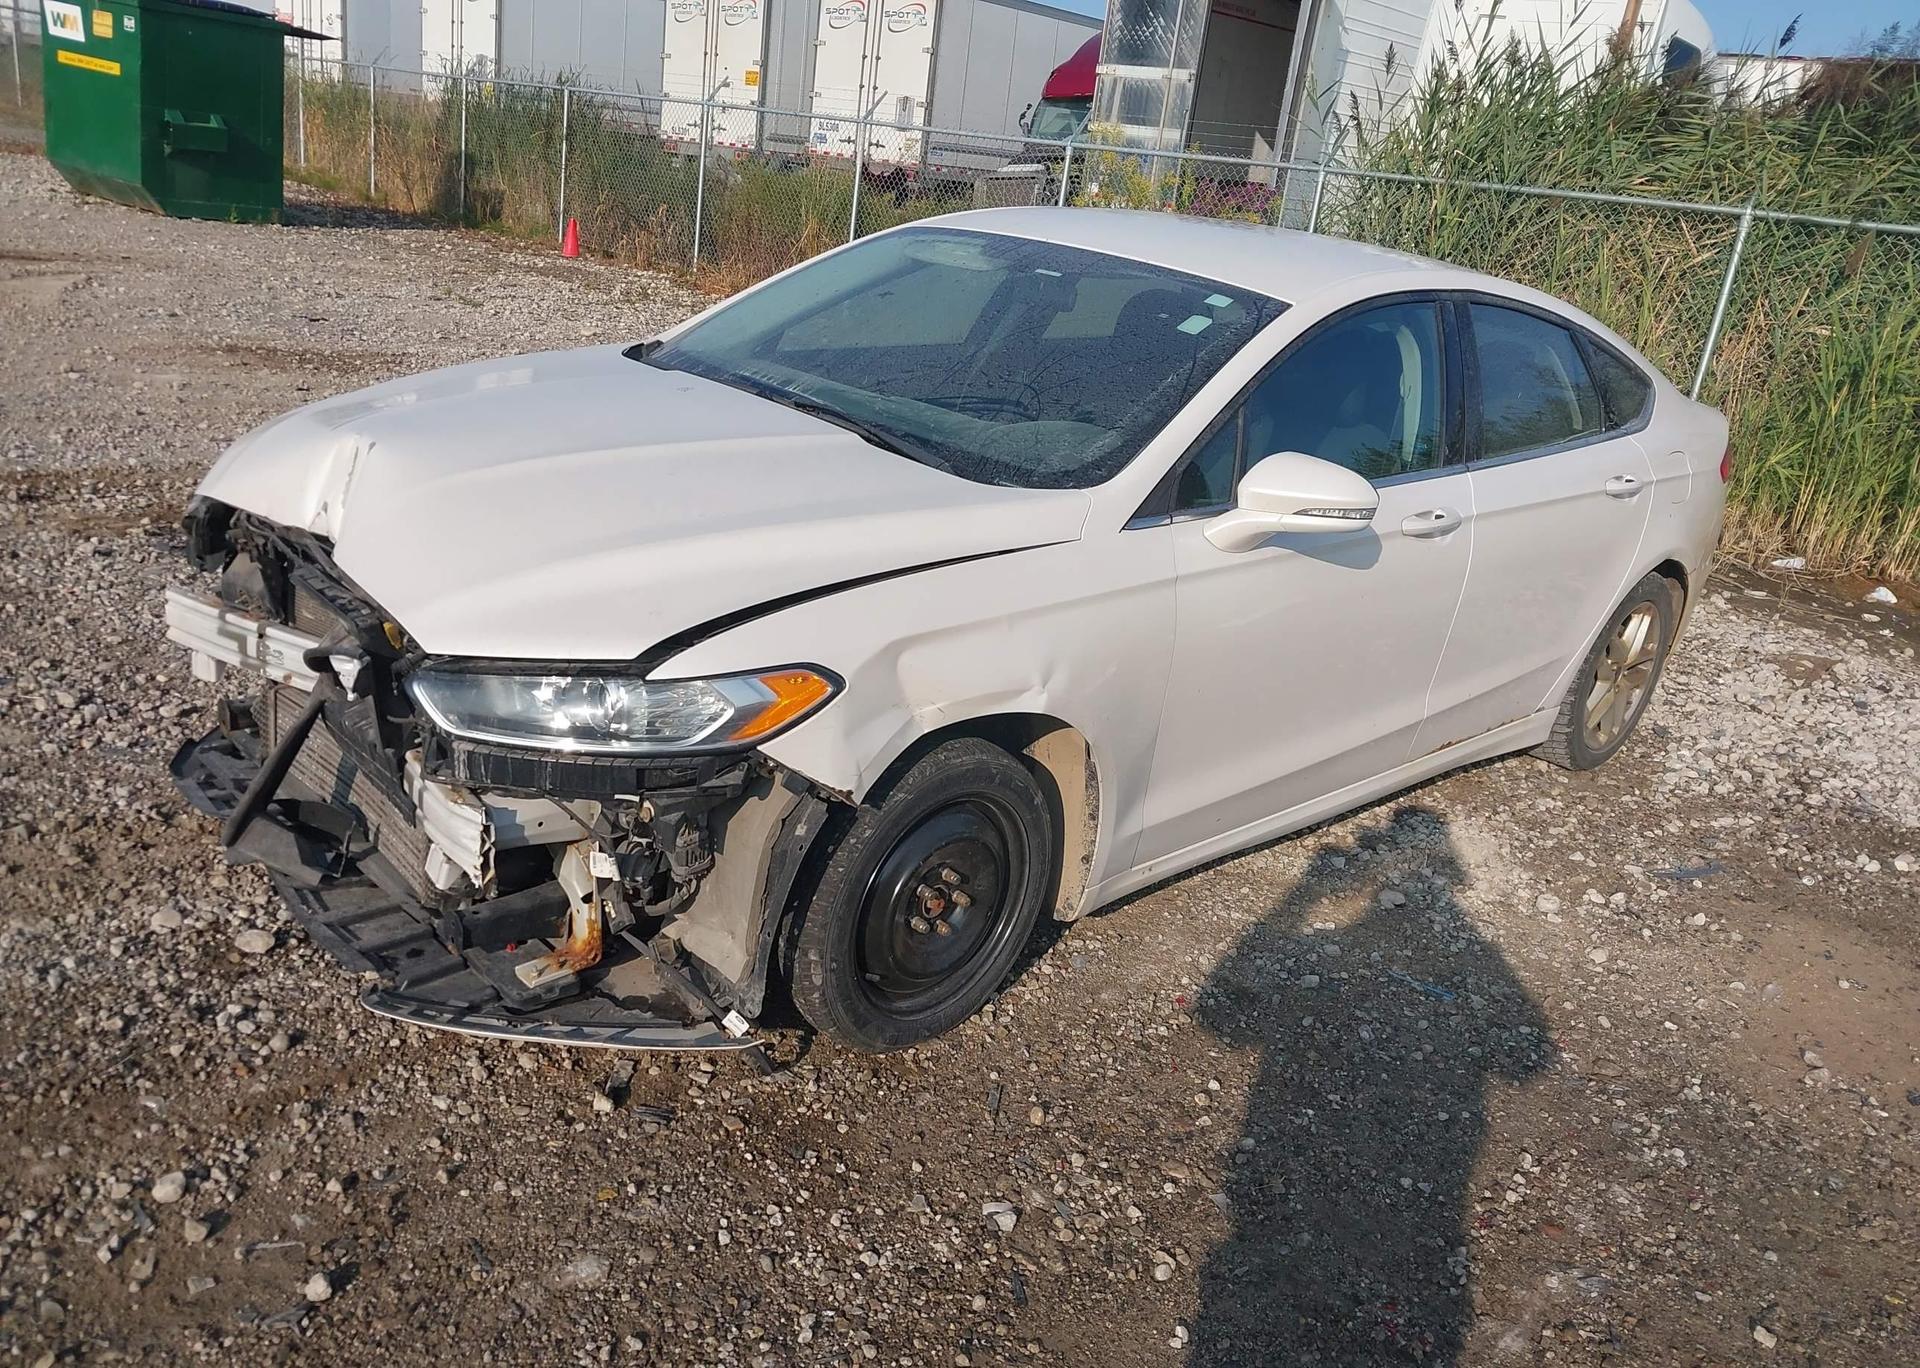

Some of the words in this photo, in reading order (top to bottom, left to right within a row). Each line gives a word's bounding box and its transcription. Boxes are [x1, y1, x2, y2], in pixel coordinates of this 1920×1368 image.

[825, 7, 851, 15] SPOT
[884, 10, 911, 18] SPOT
[50, 10, 79, 32] WM
